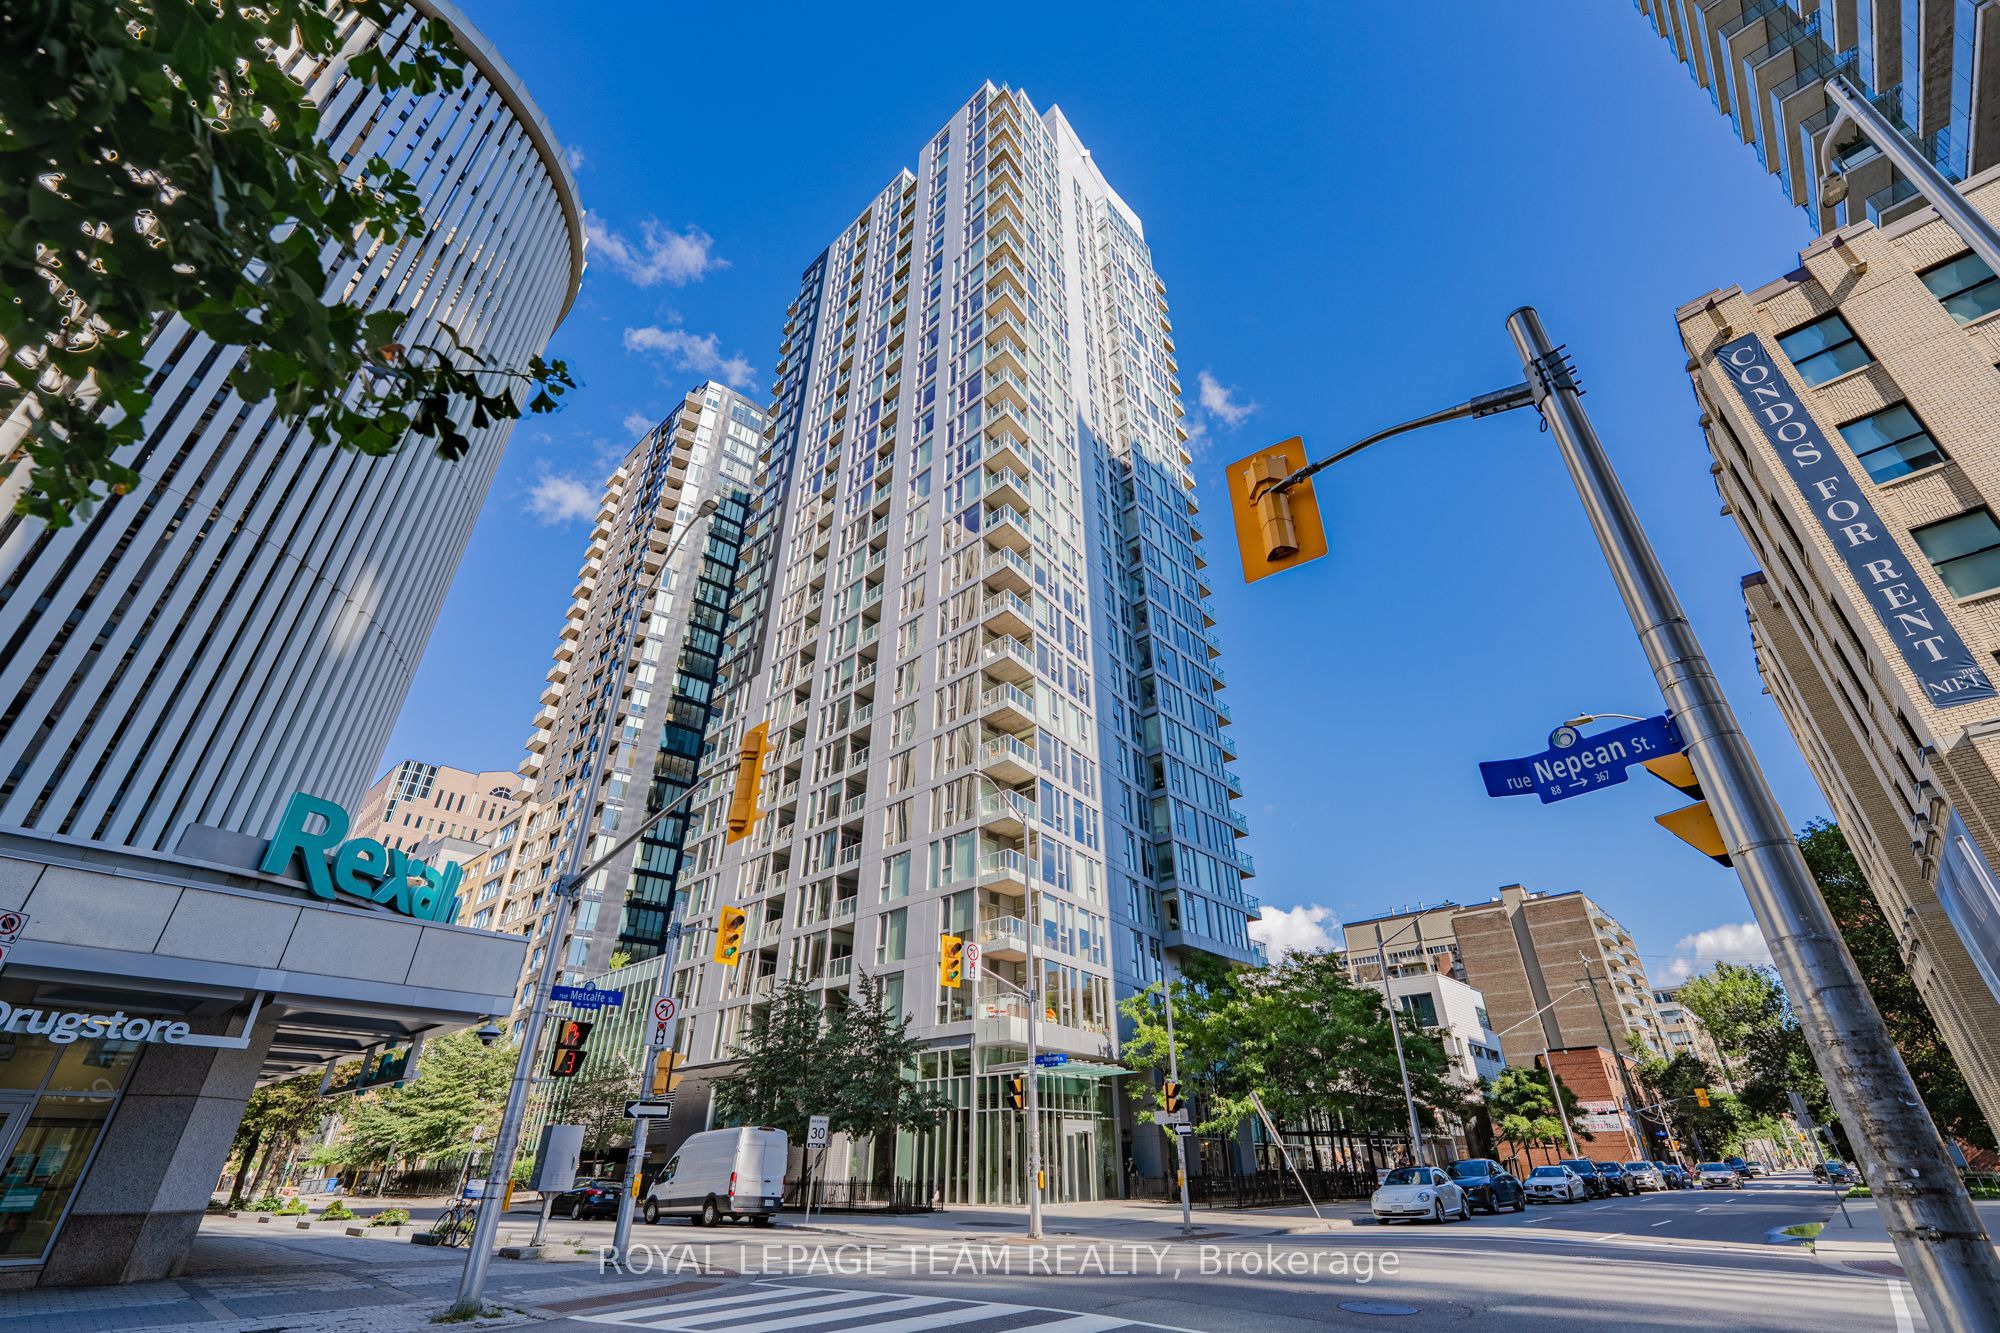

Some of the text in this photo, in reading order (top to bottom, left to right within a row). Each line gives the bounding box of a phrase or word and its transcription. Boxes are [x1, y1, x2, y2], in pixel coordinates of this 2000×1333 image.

[1731, 345, 1948, 662] CONDOS FOR RENT
[1959, 667, 1978, 675] THE
[1928, 672, 1981, 697] MET
[1507, 736, 1657, 790] rue Nepean St.
[1550, 770, 1610, 796] 88 367
[259, 791, 464, 925] Rexall
[570, 990, 605, 1002] Metcalfe
[564, 1052, 576, 1074] 3
[810, 1127, 825, 1139] 30
